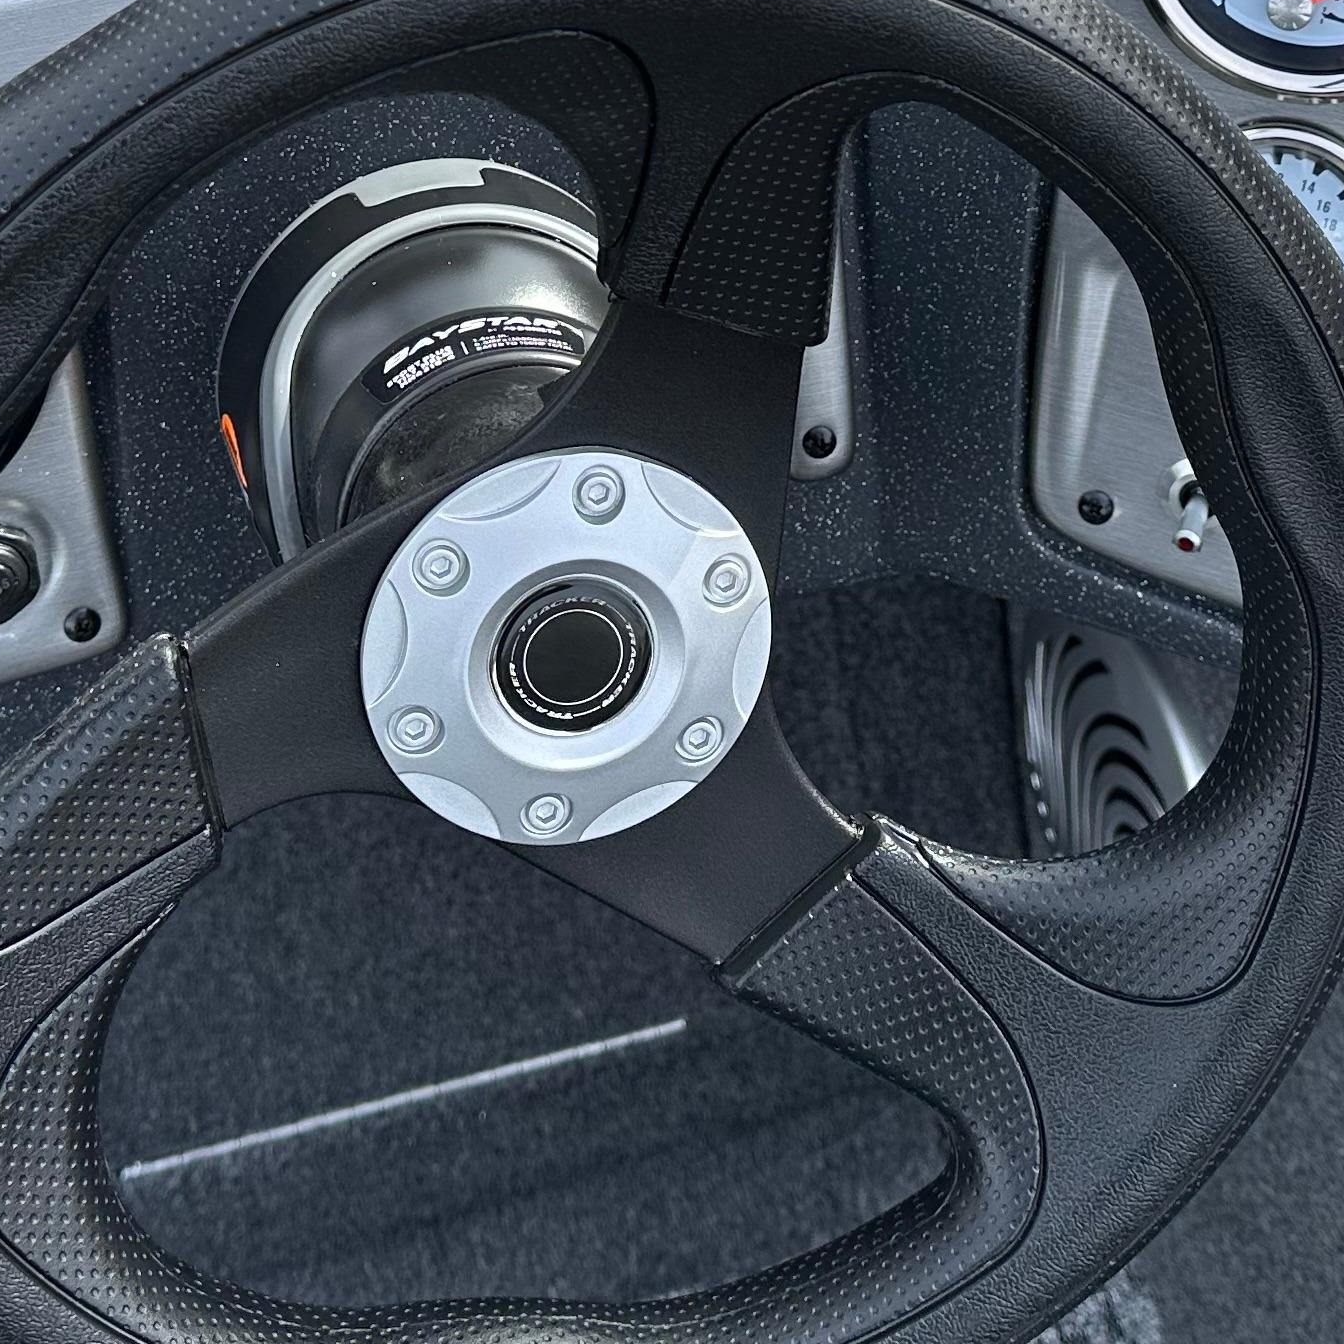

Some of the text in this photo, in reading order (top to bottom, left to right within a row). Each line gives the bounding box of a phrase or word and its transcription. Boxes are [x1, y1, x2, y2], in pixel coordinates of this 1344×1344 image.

[1301, 179, 1315, 193] 14
[1317, 200, 1331, 212] 16
[1323, 217, 1337, 230] 18
